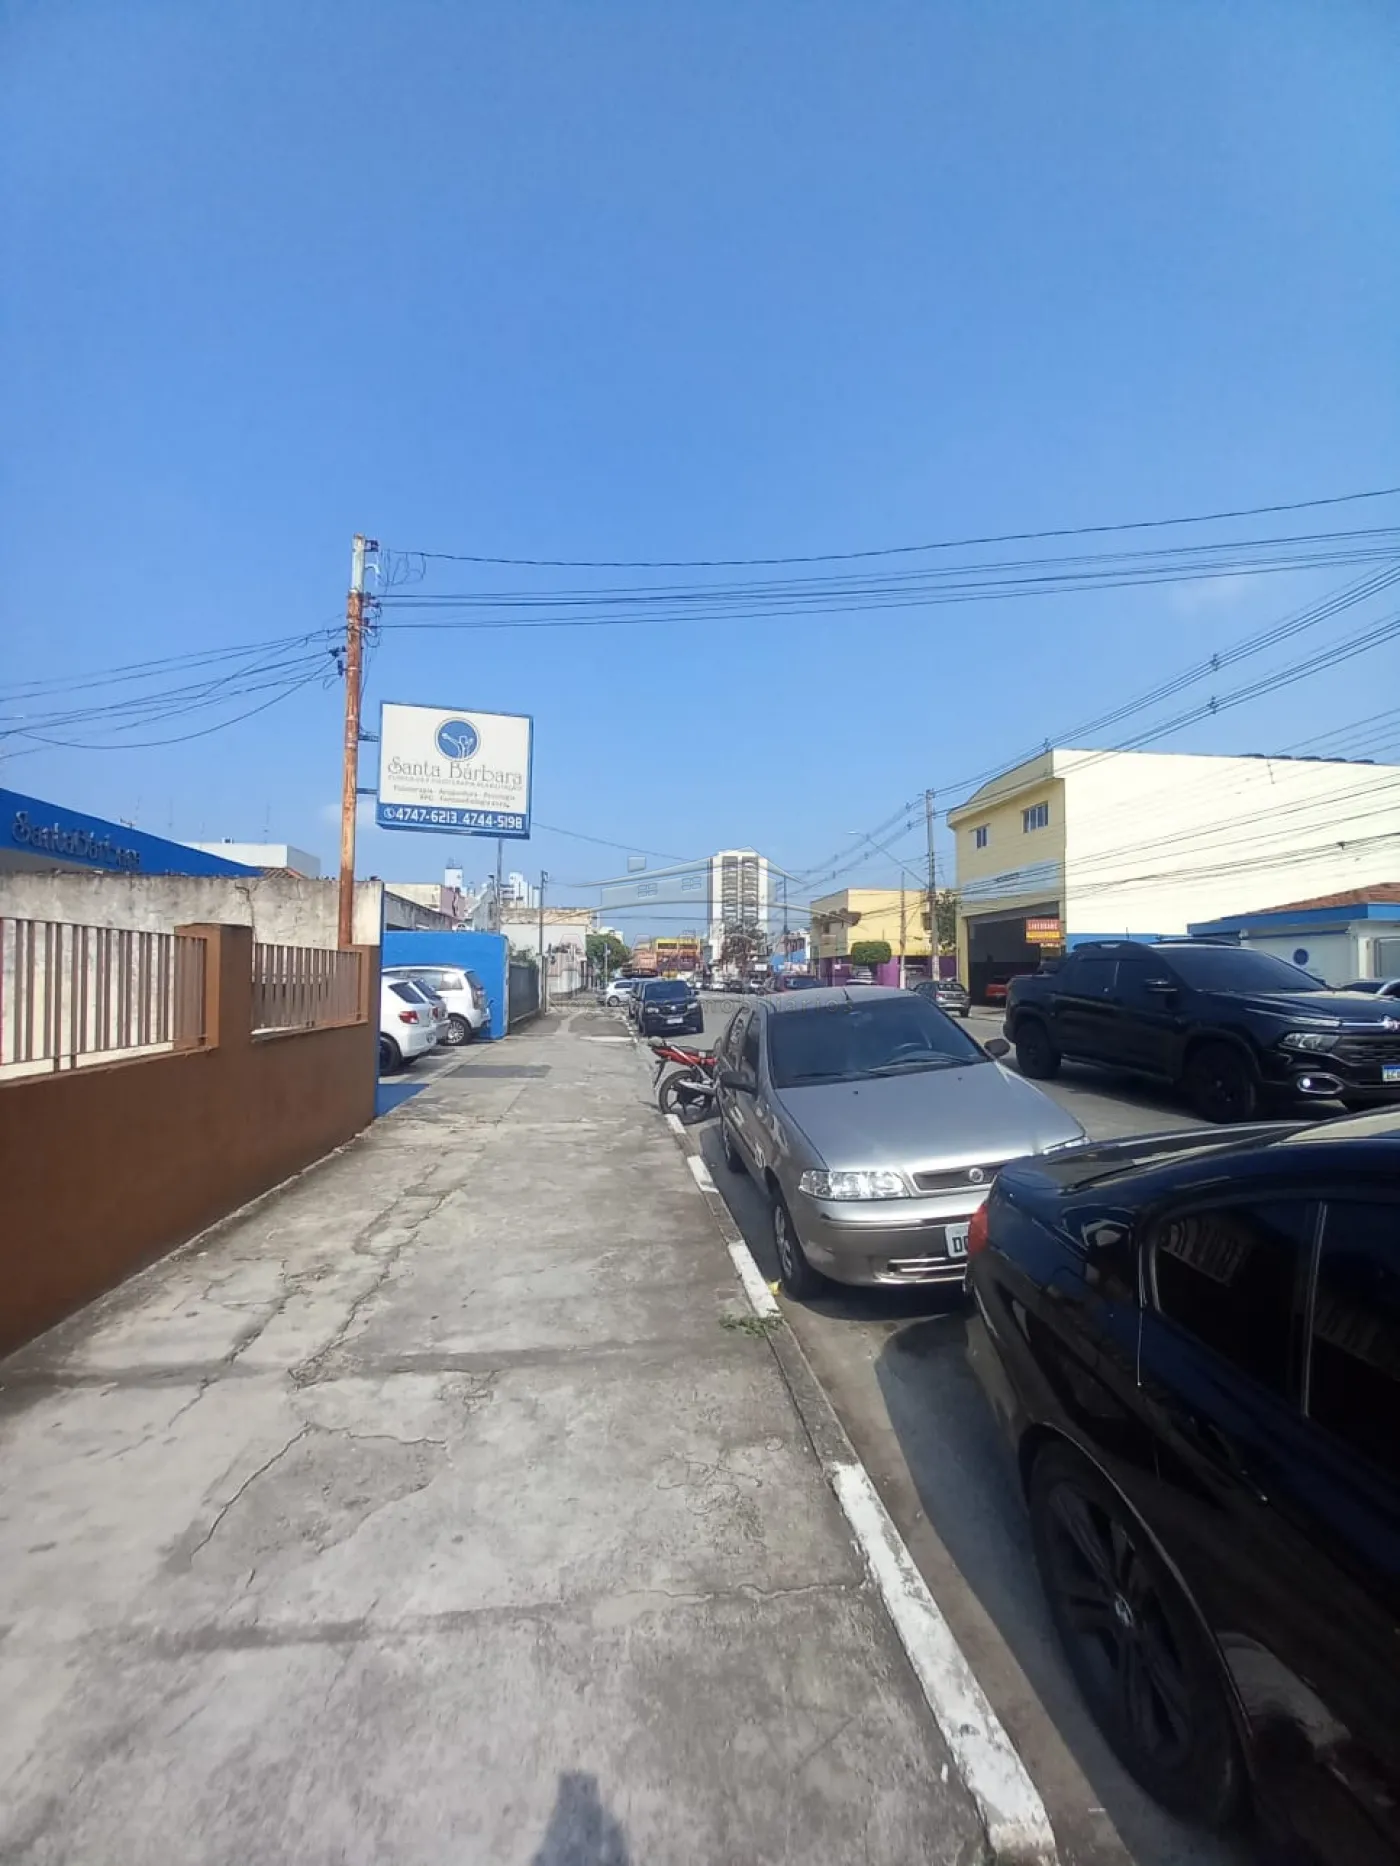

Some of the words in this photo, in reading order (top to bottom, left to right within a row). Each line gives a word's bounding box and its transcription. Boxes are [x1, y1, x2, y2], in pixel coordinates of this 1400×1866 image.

[388, 756, 440, 776] Santa
[449, 760, 523, 785] Bárbara
[396, 808, 457, 823] 4747-6213
[463, 814, 522, 829] 4744-5198
